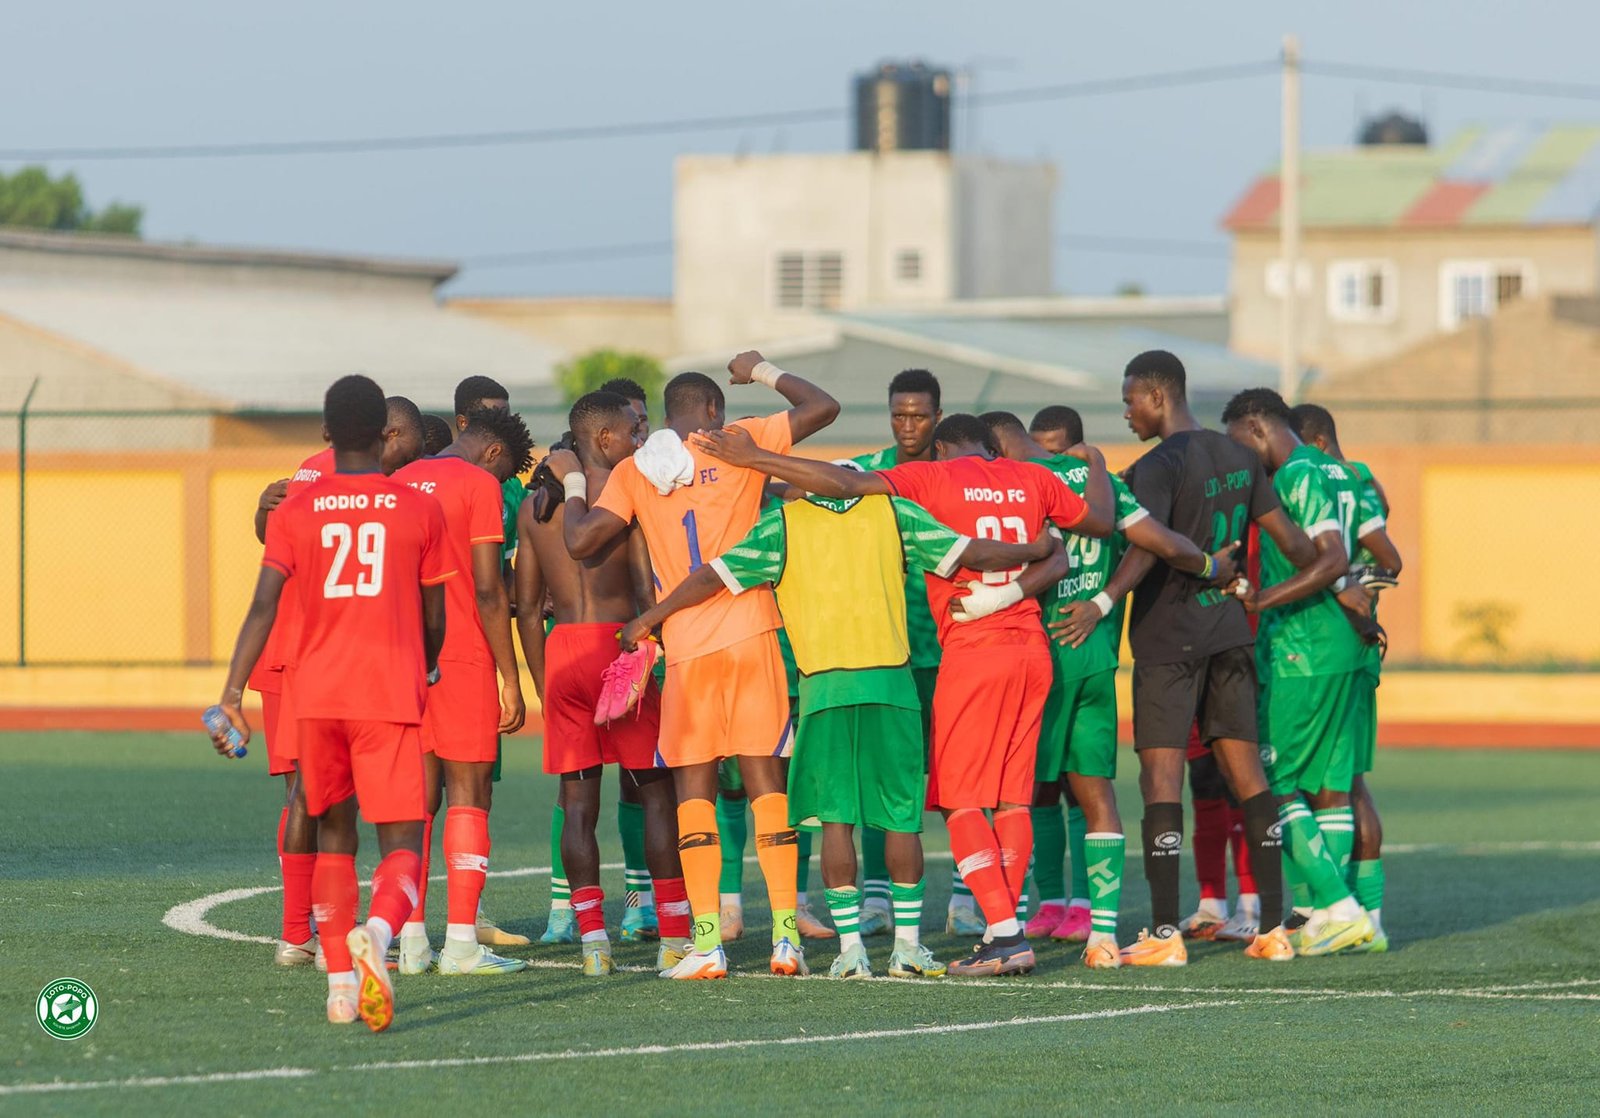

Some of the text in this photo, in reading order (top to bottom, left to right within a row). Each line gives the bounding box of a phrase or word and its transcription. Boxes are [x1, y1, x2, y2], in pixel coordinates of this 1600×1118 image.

[700, 468, 718, 484] FC
[420, 482, 437, 494] FC
[1007, 489, 1026, 503] FC
[313, 494, 397, 512] HODIO FC
[681, 509, 703, 574] 1
[321, 522, 386, 599] 29
